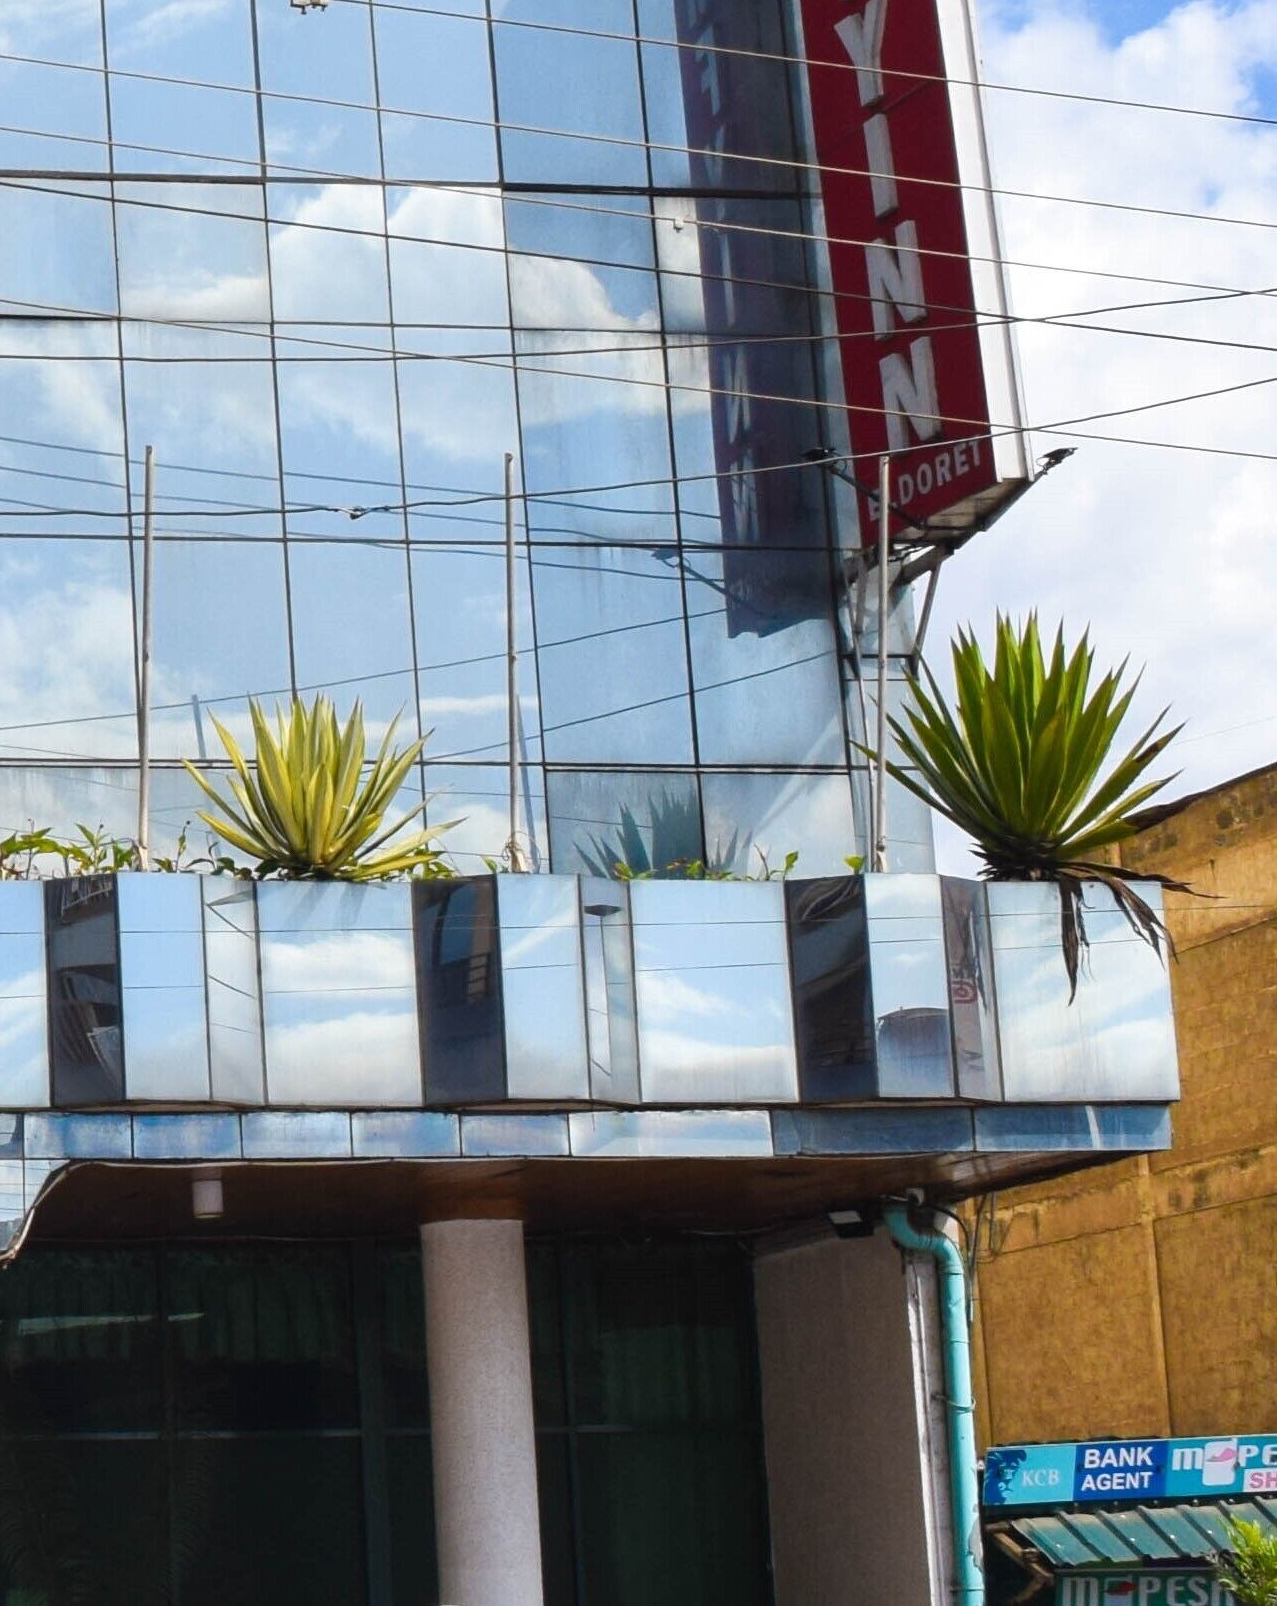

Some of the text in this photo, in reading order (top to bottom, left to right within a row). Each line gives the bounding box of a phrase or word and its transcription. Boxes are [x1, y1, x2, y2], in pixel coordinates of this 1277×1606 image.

[867, 436, 981, 522] EDORET
[1083, 1446, 1154, 1469] BANK
[1021, 1469, 1061, 1487] KCB
[1080, 1471, 1154, 1492] AGENT
